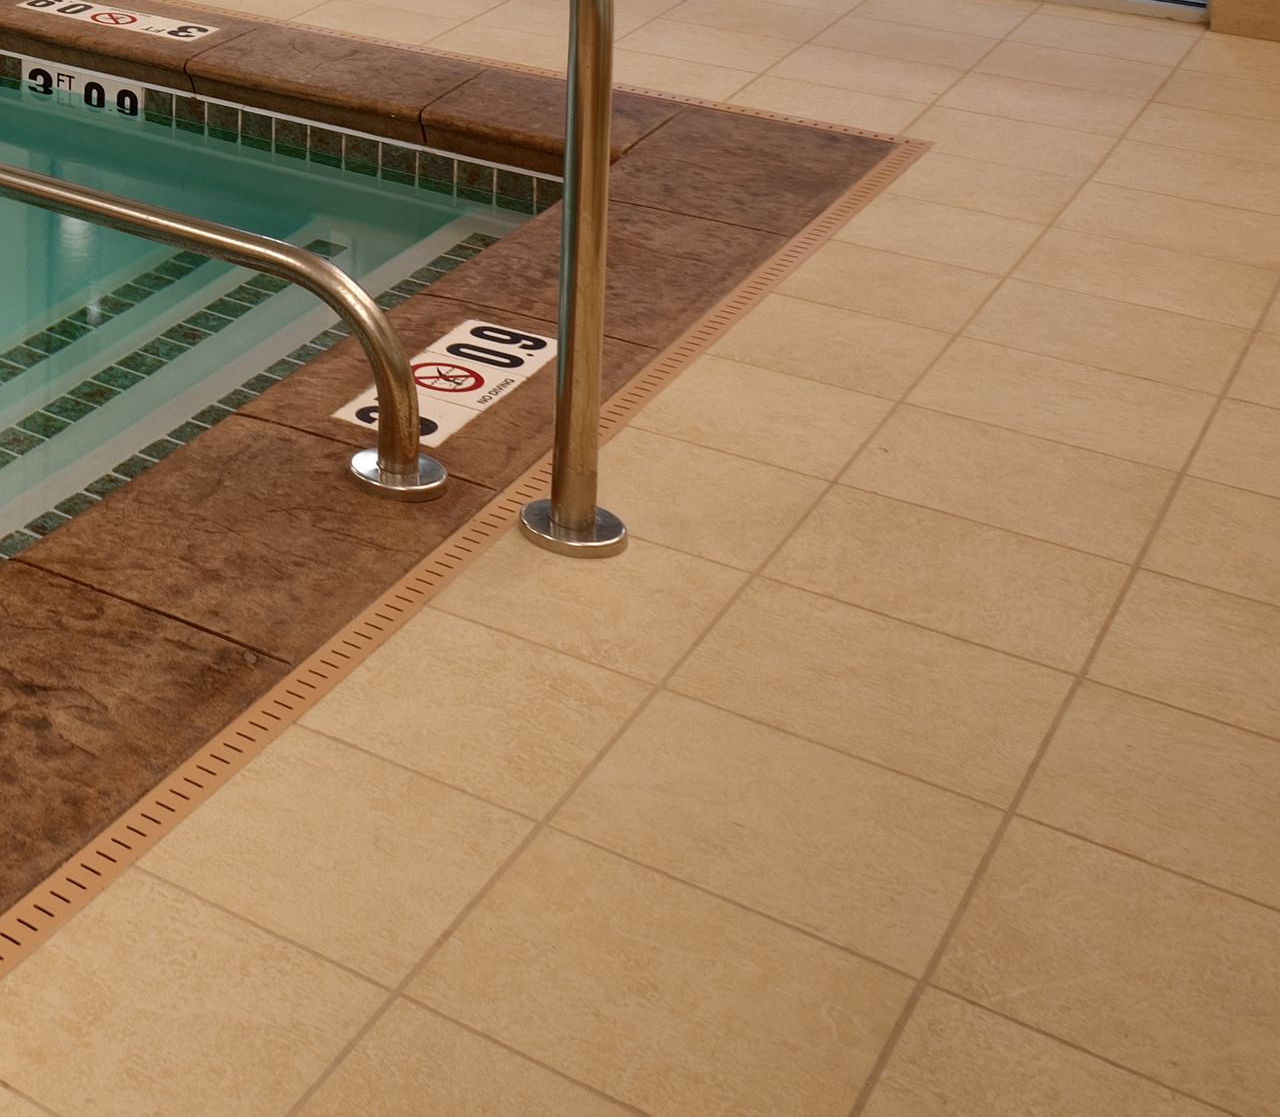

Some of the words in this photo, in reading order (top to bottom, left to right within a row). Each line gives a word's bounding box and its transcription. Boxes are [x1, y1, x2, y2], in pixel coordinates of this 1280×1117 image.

[28, 68, 53, 96] 3
[57, 72, 75, 91] FT
[477, 394, 494, 406] NO
[489, 377, 516, 398] DIVING
